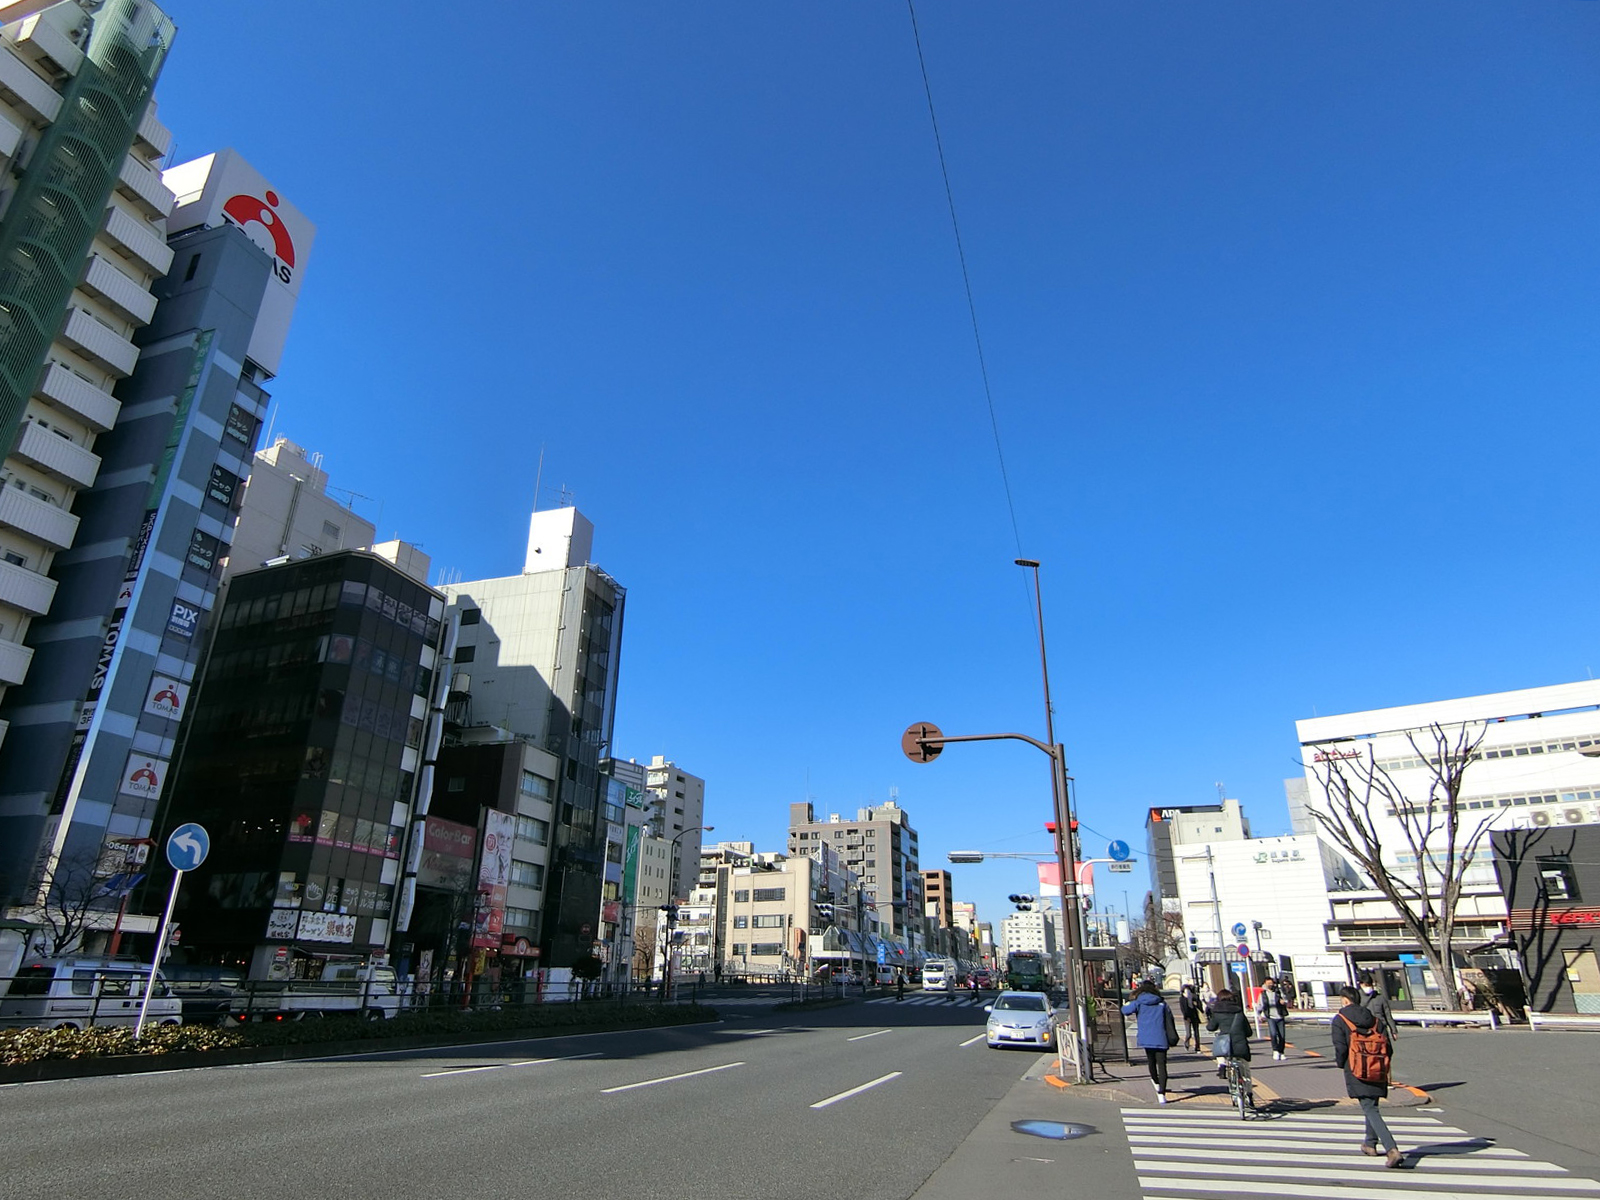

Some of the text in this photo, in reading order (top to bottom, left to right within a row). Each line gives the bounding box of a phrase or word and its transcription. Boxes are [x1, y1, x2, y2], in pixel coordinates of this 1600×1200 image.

[221, 213, 292, 284] TAS
[92, 618, 123, 689] TOMAS
[152, 701, 179, 715] TOMAS
[129, 782, 157, 794] TOMAS
